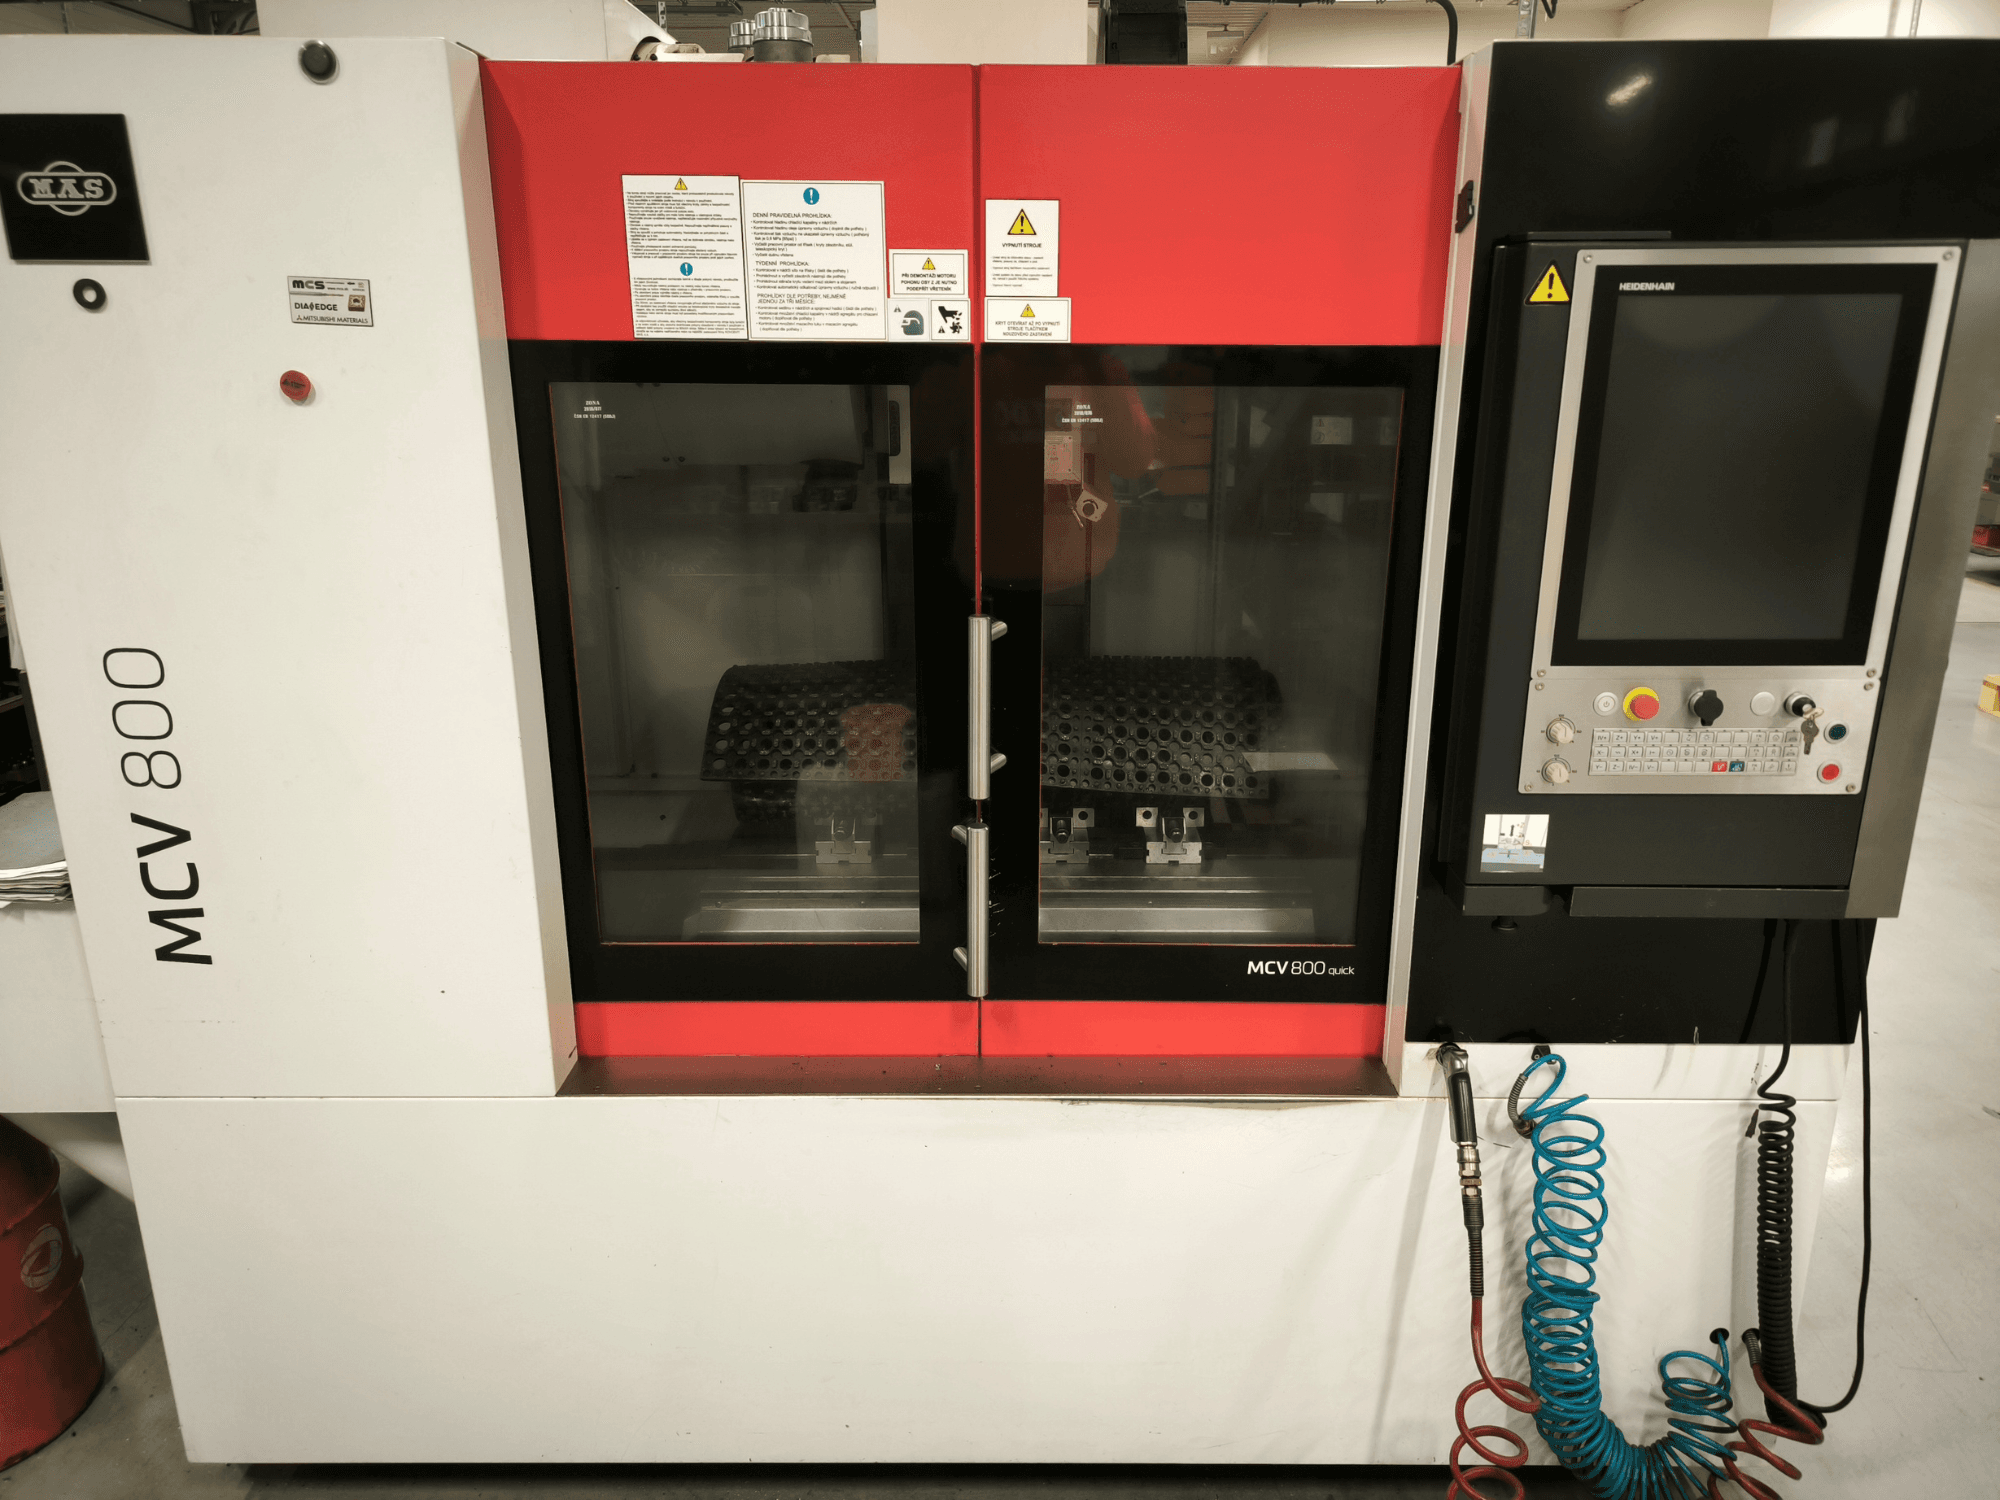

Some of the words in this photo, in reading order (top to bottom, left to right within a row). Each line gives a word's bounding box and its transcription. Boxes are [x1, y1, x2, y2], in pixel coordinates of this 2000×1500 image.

[29, 179, 104, 199] MAS
[1619, 282, 1675, 291] HEIDENHAIN
[103, 647, 182, 790] 800
[130, 812, 213, 965] MCV
[1247, 961, 1288, 975] MCV
[1291, 961, 1326, 975] 800
[1328, 966, 1355, 976] quick
